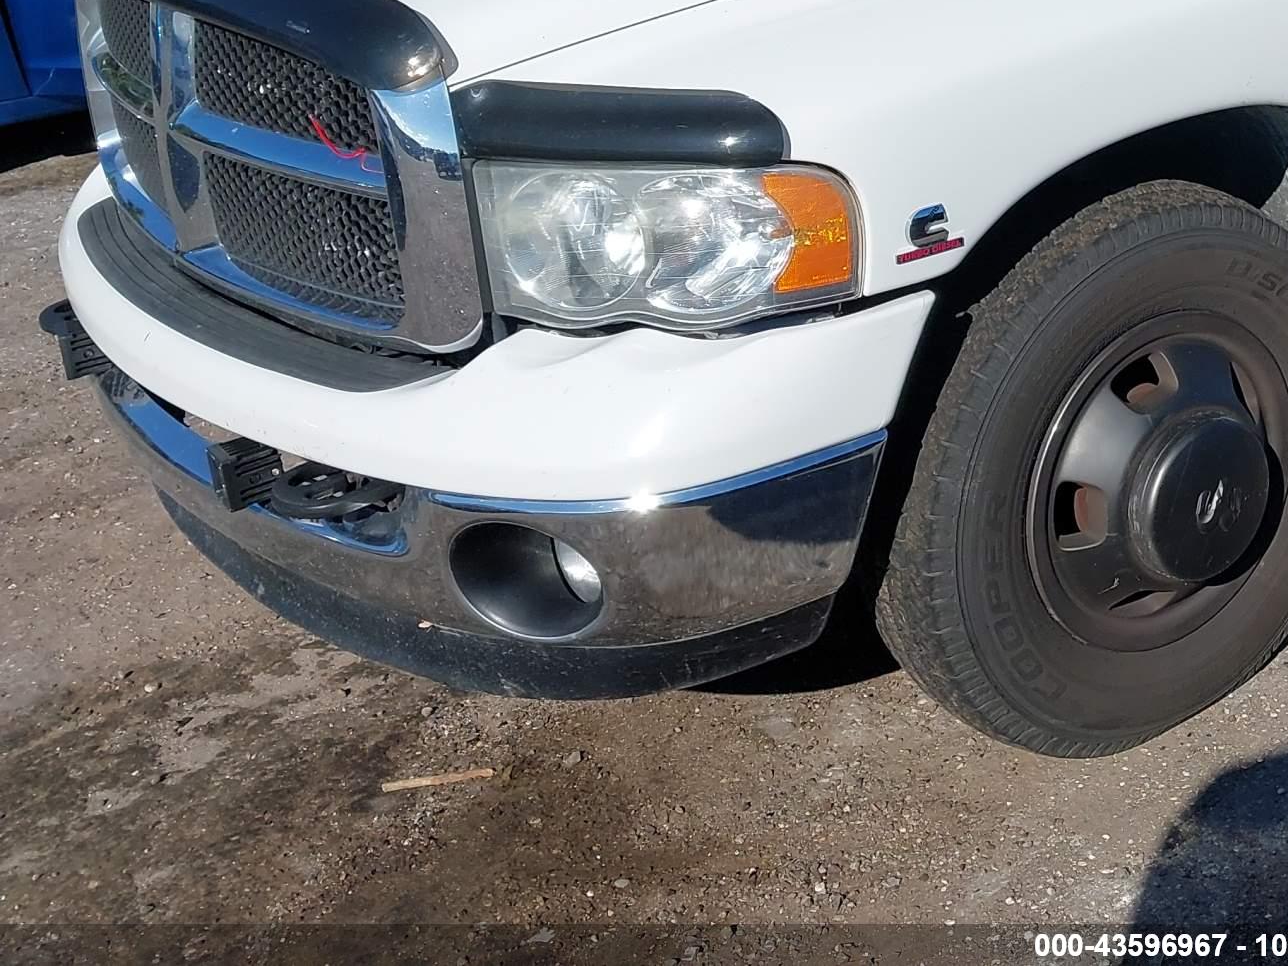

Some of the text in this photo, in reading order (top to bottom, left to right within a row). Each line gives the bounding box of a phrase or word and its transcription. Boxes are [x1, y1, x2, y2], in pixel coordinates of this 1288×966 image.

[898, 239, 962, 263] TURBO DIESEL
[982, 491, 1069, 702] COOPER
